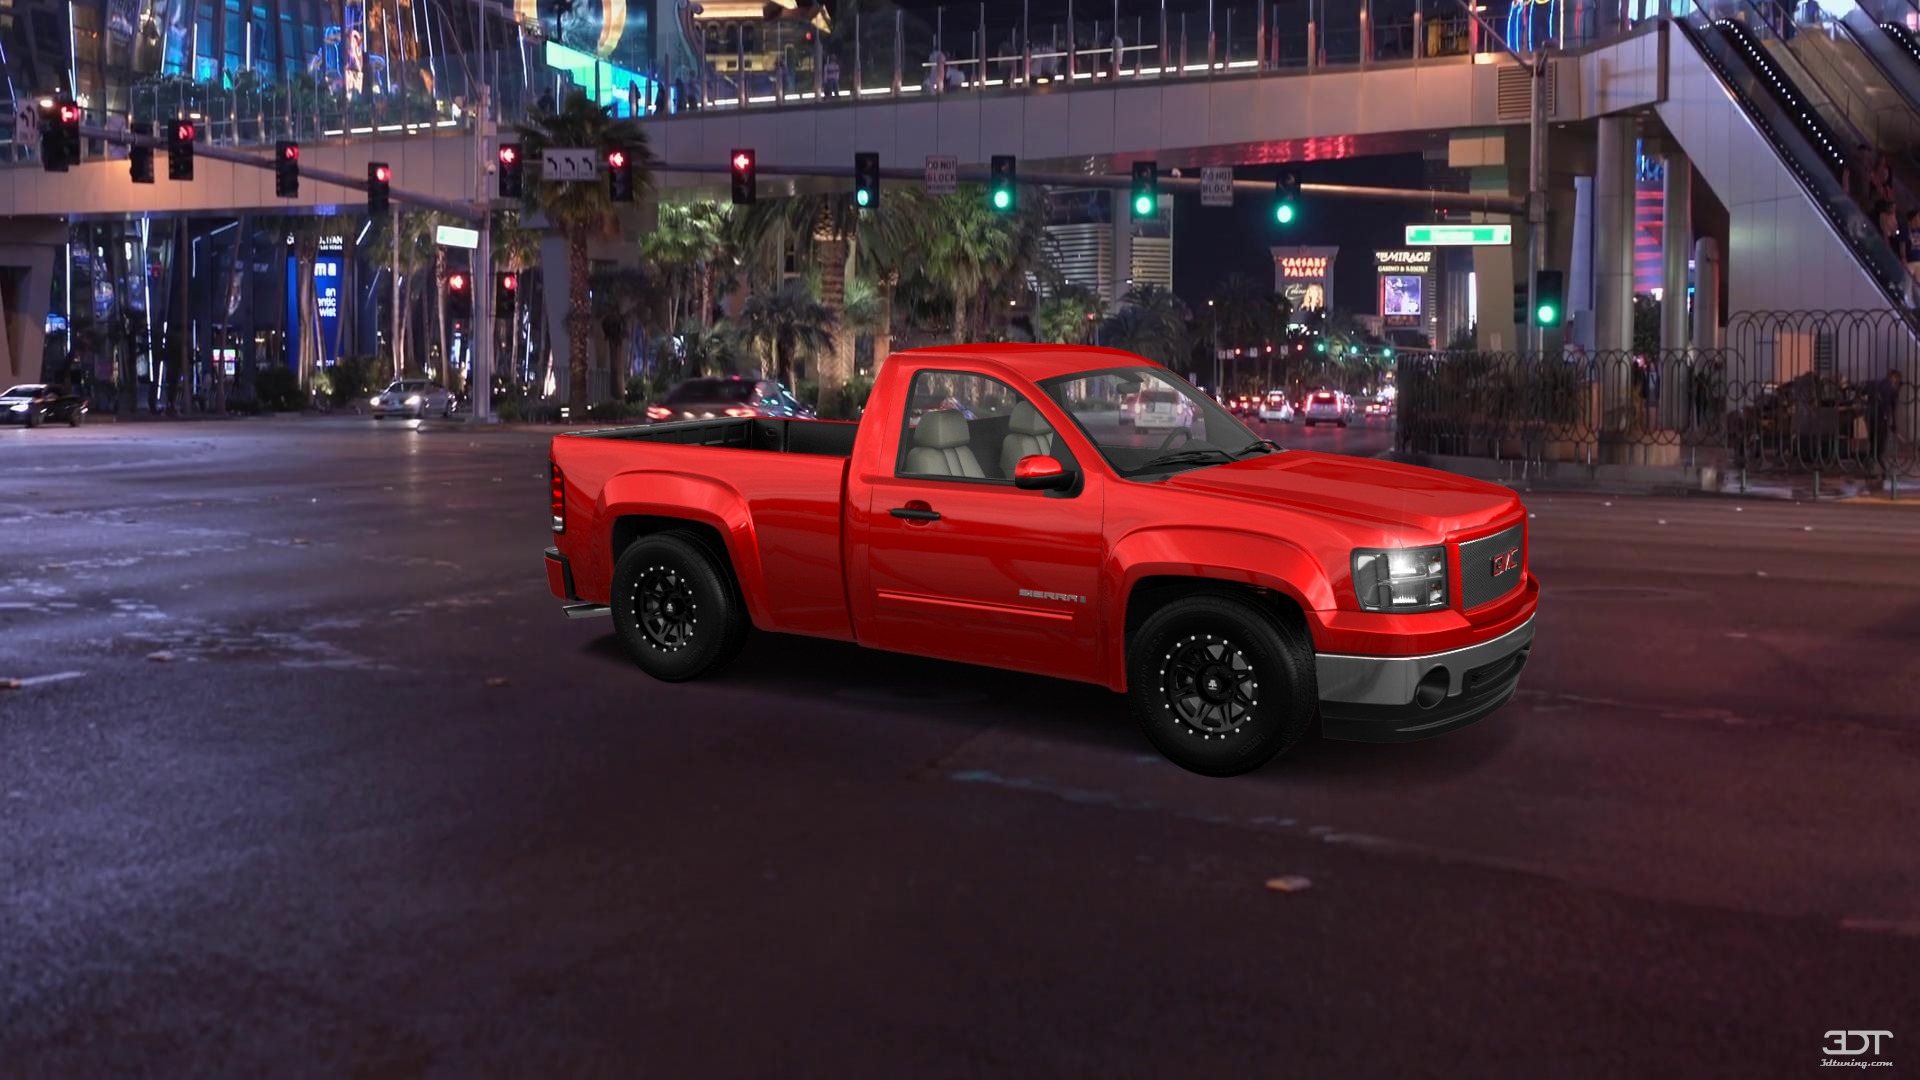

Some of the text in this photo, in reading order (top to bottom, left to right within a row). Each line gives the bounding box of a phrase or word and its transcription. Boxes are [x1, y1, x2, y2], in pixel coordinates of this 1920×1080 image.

[928, 160, 955, 170] DO NOT
[927, 173, 956, 183] BLOCK
[1202, 184, 1231, 193] BLOCK
[1281, 257, 1327, 268] CAESARS
[1387, 251, 1432, 263] MIRAGE
[1284, 267, 1325, 278] PALACE
[1492, 546, 1519, 577] GMC
[1019, 588, 1079, 603] SIERRA
